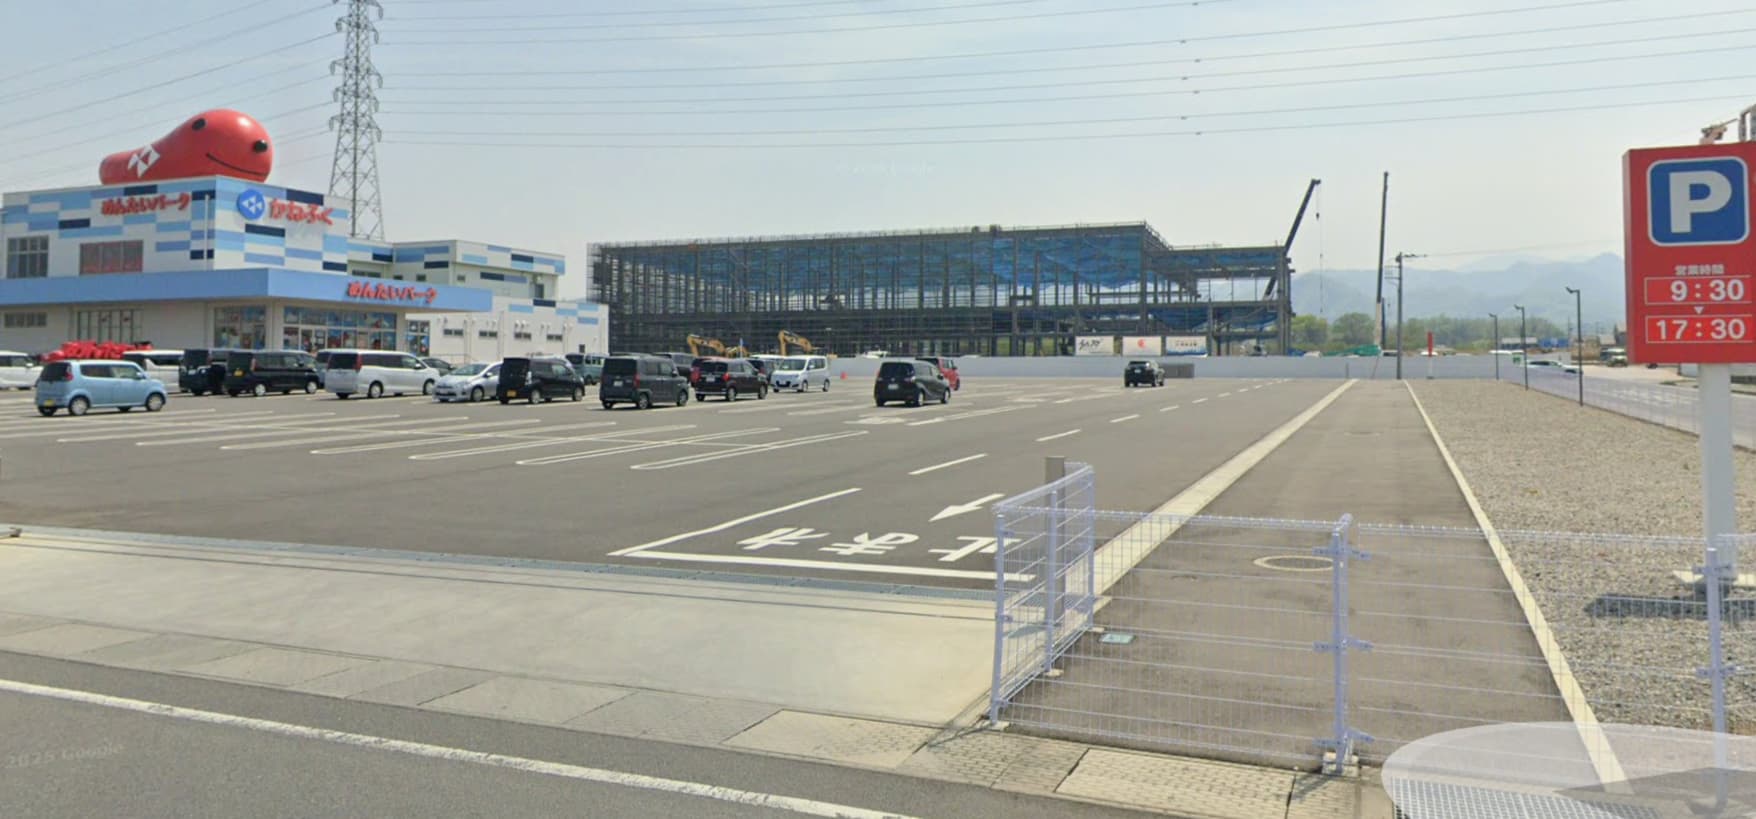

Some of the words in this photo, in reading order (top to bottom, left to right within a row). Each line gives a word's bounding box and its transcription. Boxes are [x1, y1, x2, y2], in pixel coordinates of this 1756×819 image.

[102, 192, 191, 215] めんたいパーク
[270, 198, 334, 226] かねふく
[1669, 170, 1732, 233] P
[348, 281, 437, 303] めんたいパーク
[1671, 279, 1744, 301] 9:30
[1656, 319, 1745, 340] 17:30
